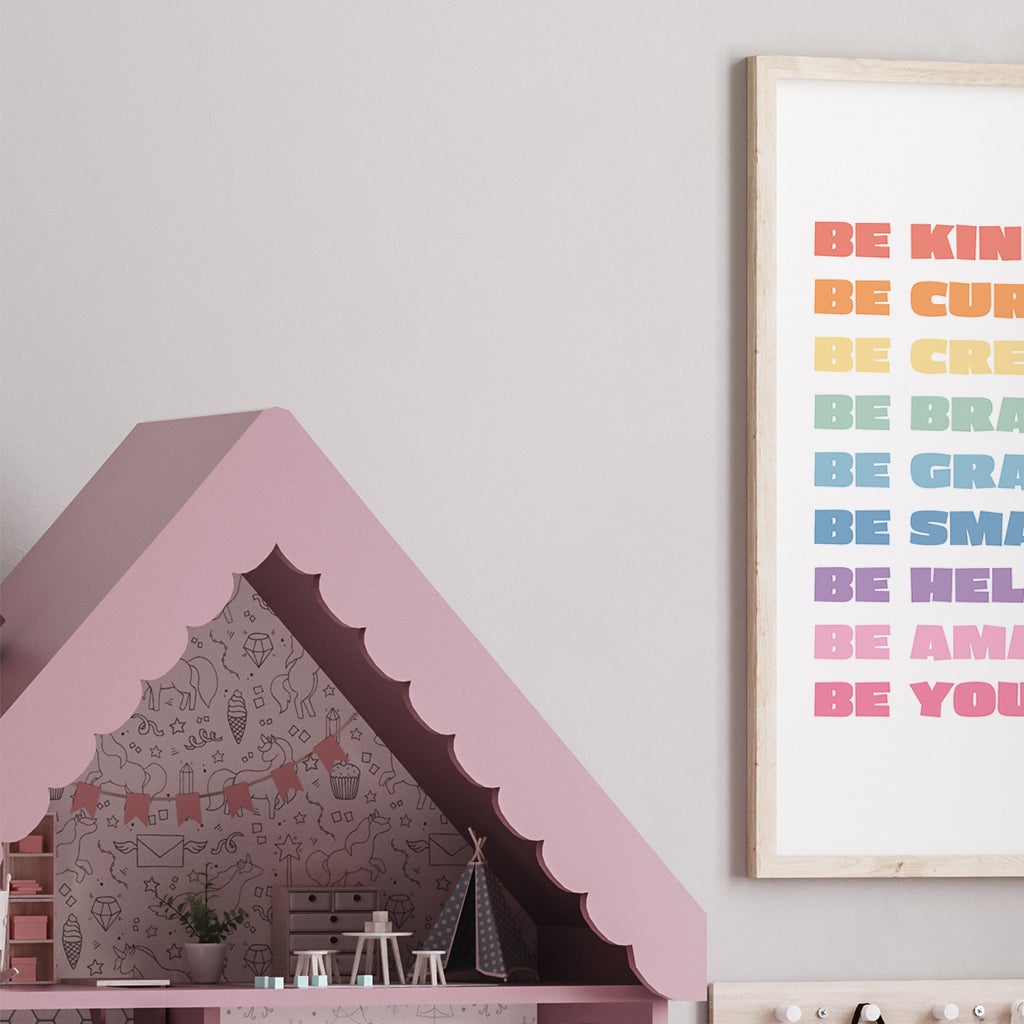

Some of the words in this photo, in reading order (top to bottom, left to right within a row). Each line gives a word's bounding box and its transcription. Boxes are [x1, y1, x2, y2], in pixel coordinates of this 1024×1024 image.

[814, 221, 891, 259] BE
[813, 279, 891, 317] BE
[814, 336, 891, 374] BE
[814, 394, 891, 431] BE
[814, 452, 891, 488] BE
[814, 509, 891, 546] BE
[814, 567, 891, 603] BE
[814, 624, 891, 661] BE
[814, 681, 891, 718] BE
